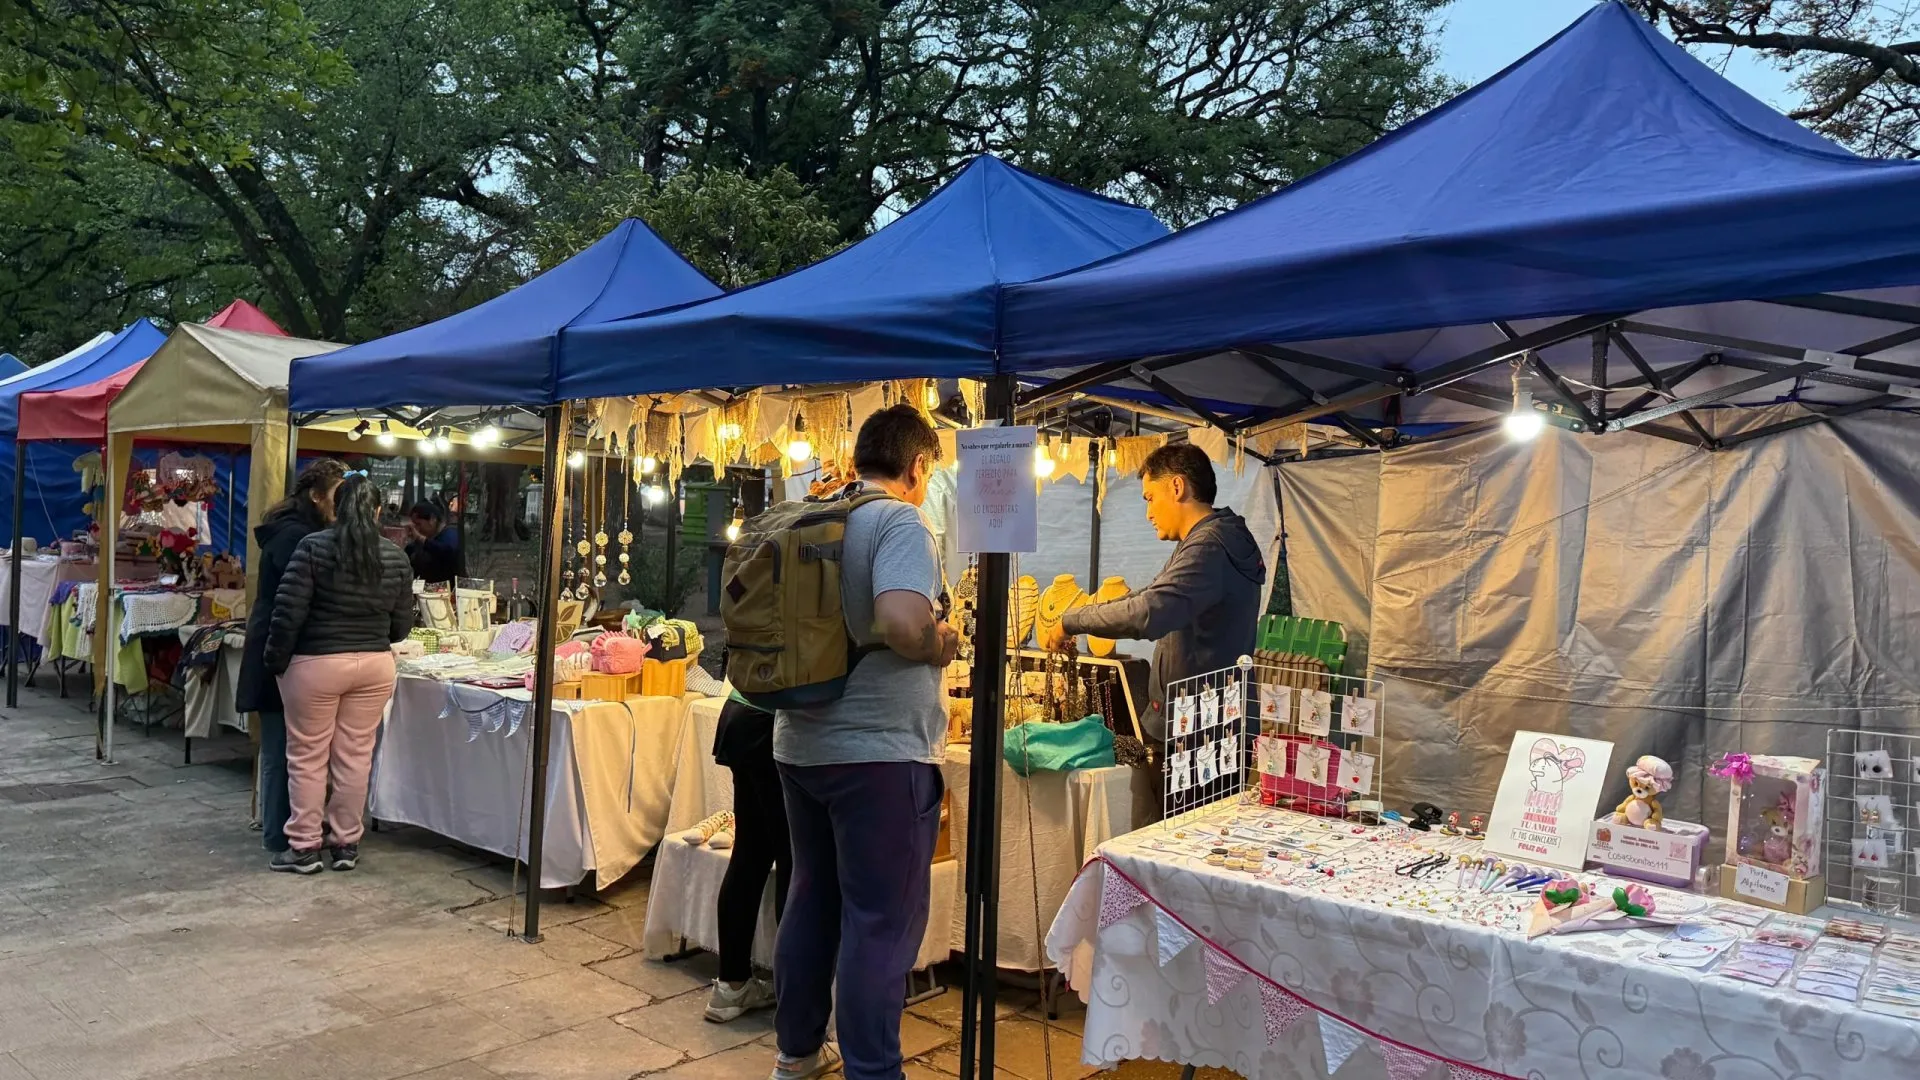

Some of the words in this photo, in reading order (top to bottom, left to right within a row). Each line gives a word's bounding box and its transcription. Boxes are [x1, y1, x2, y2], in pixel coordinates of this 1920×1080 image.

[989, 454, 1011, 464] REGALO
[975, 468, 1002, 479] PERFECTO
[1003, 468, 1017, 479] PARA
[973, 503, 981, 513] LO
[982, 503, 1018, 514] ENCUENTRAS
[1520, 820, 1531, 829] TU
[1531, 822, 1557, 834] AMOR
[1518, 831, 1527, 841] TUS
[1518, 843, 1535, 852] FELIZ
[1536, 845, 1548, 854] DÍA
